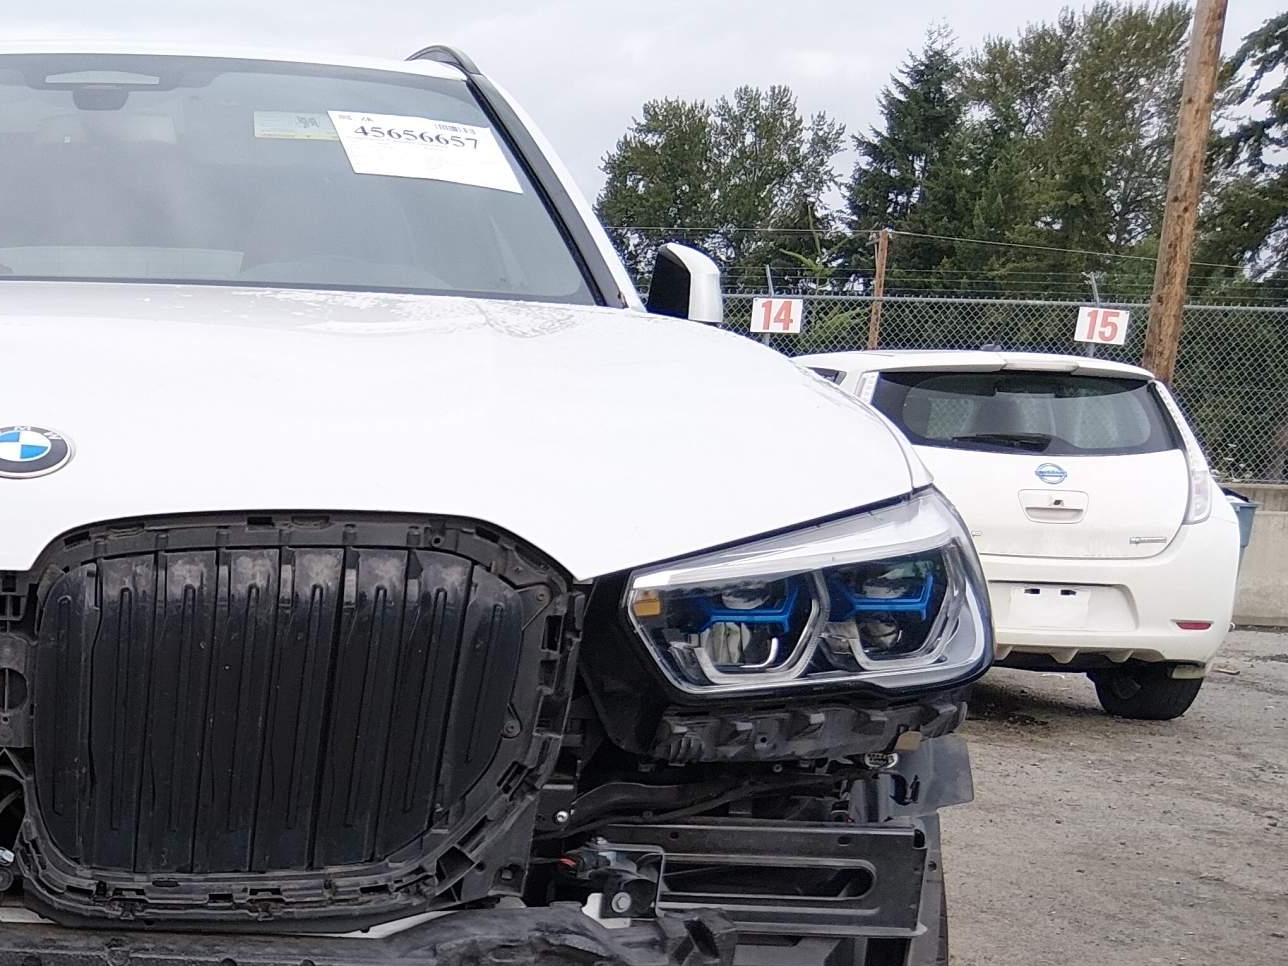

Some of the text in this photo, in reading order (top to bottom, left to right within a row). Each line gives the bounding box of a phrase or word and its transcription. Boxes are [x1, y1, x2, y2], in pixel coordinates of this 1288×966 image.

[354, 126, 478, 149] 45656657
[761, 300, 793, 330] 14
[1086, 310, 1120, 341] 15
